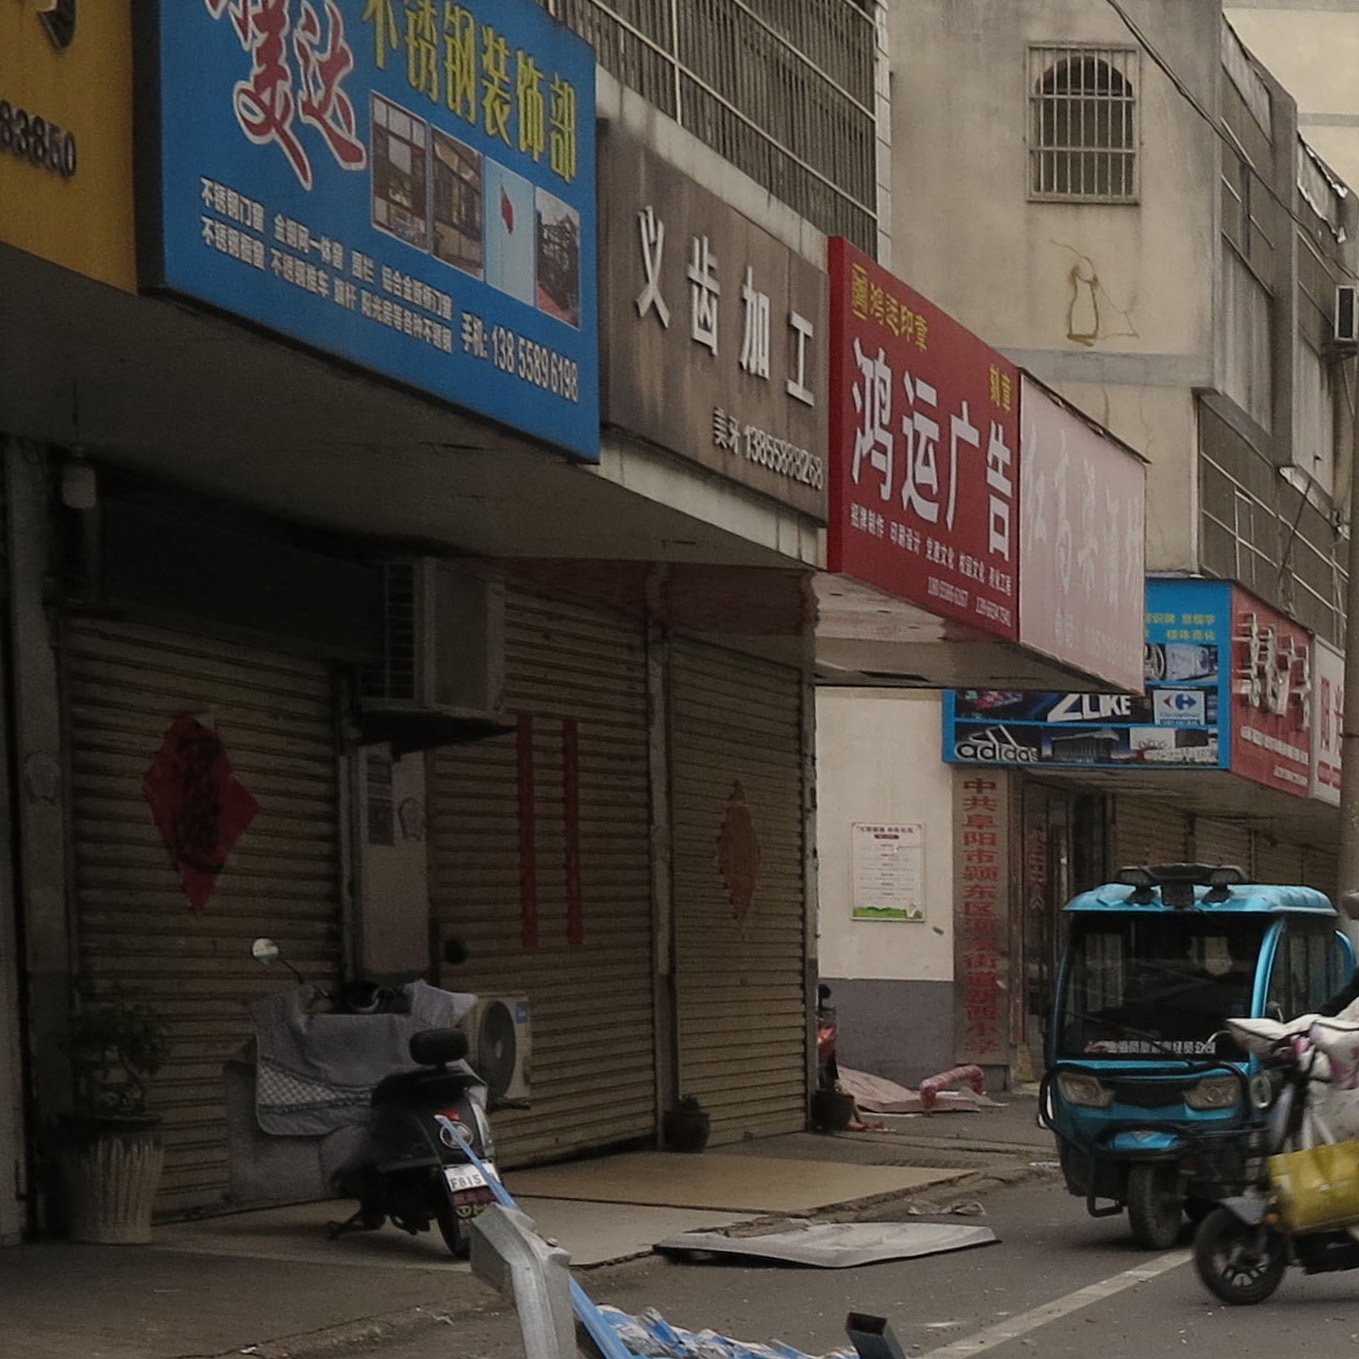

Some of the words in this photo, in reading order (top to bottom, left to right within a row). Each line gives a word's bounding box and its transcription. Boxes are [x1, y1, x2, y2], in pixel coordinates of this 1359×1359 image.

[364, 0, 578, 184] 不锈钢装饰部
[492, 325, 514, 374] 138
[634, 204, 815, 408] 义齿加工
[714, 406, 741, 455] 美牙
[852, 337, 1012, 562] 鸿运广告
[957, 736, 1039, 763] adidas
